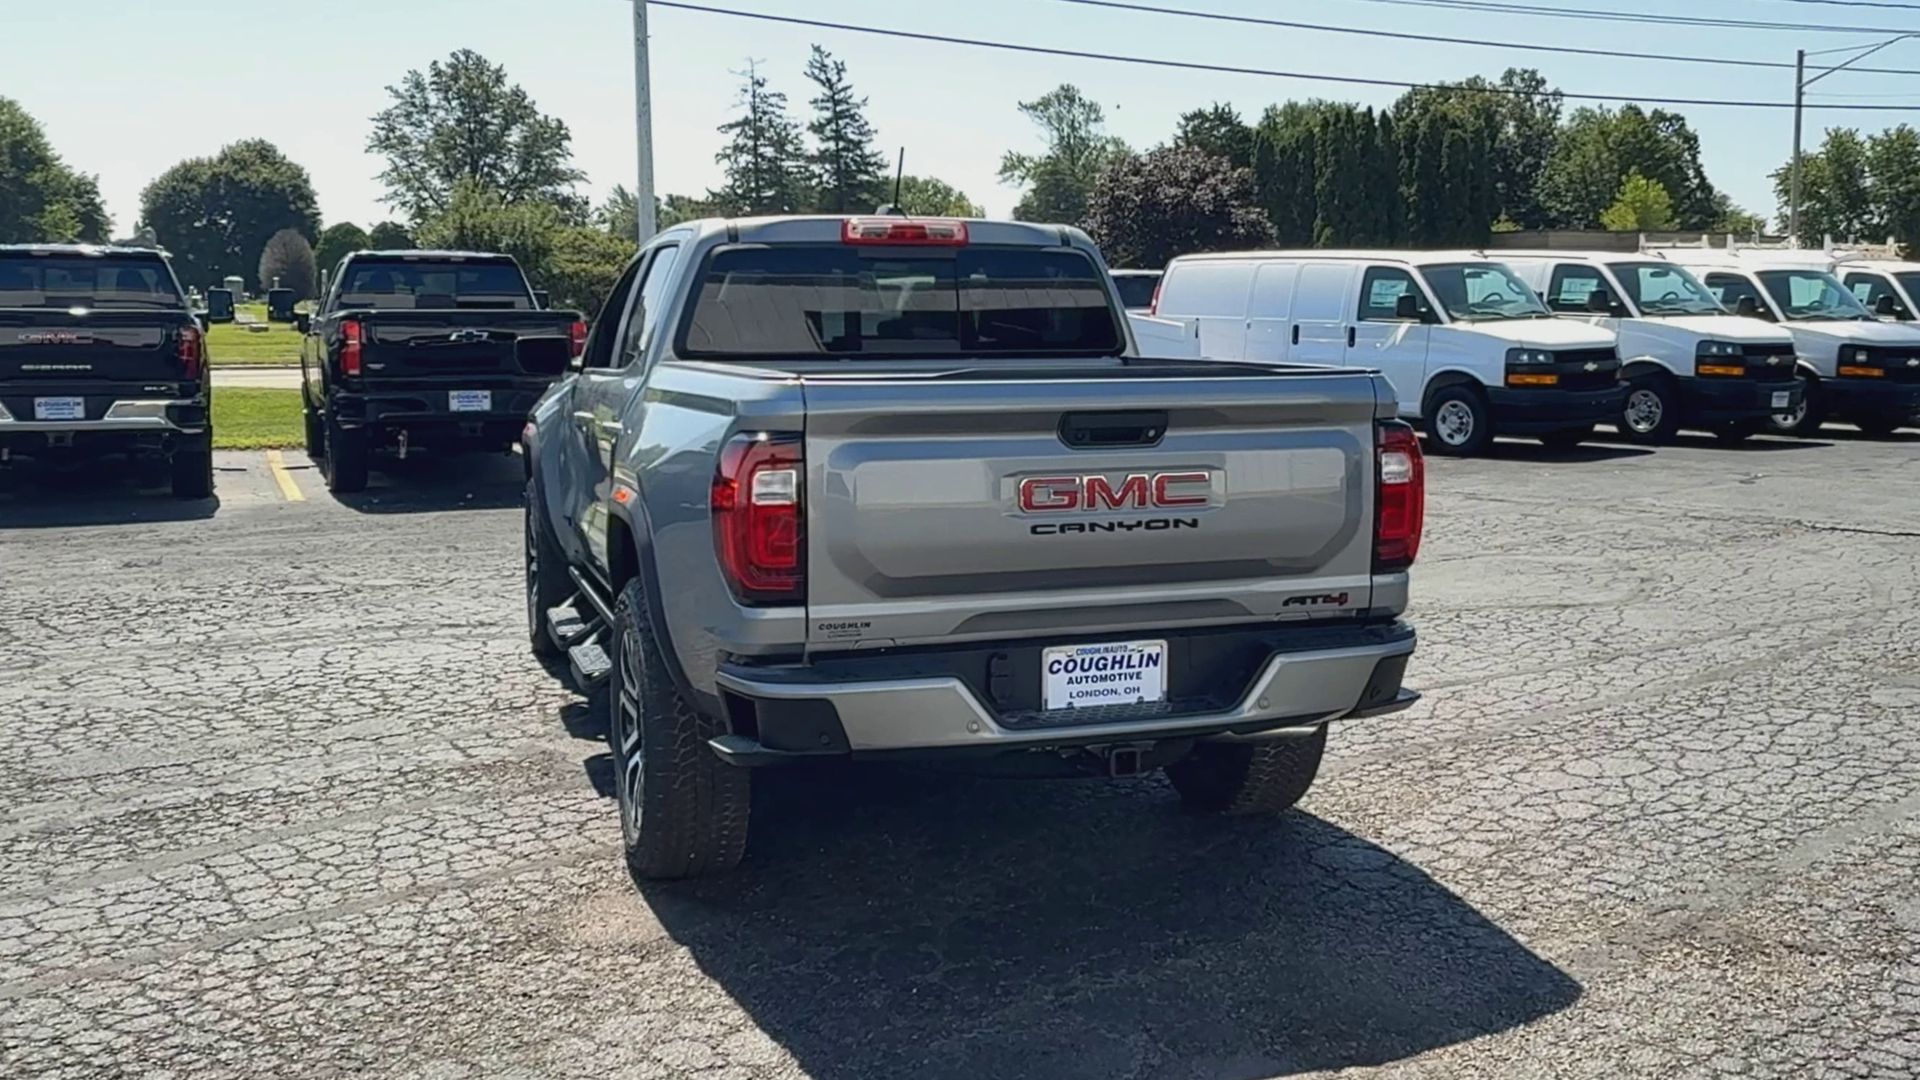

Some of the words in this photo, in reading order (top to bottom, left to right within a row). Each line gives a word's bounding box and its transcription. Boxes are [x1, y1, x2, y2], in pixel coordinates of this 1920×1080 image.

[1019, 471, 1210, 514] GMC
[1030, 518, 1199, 535] CANYON
[1282, 592, 1348, 607] AT4
[818, 621, 872, 631] COUGHLIN
[1048, 652, 1161, 675] COUGHLIN
[1066, 671, 1143, 686] AUTOMOTIVE
[1069, 687, 1121, 699] LONDON,
[1123, 686, 1141, 696] OH
